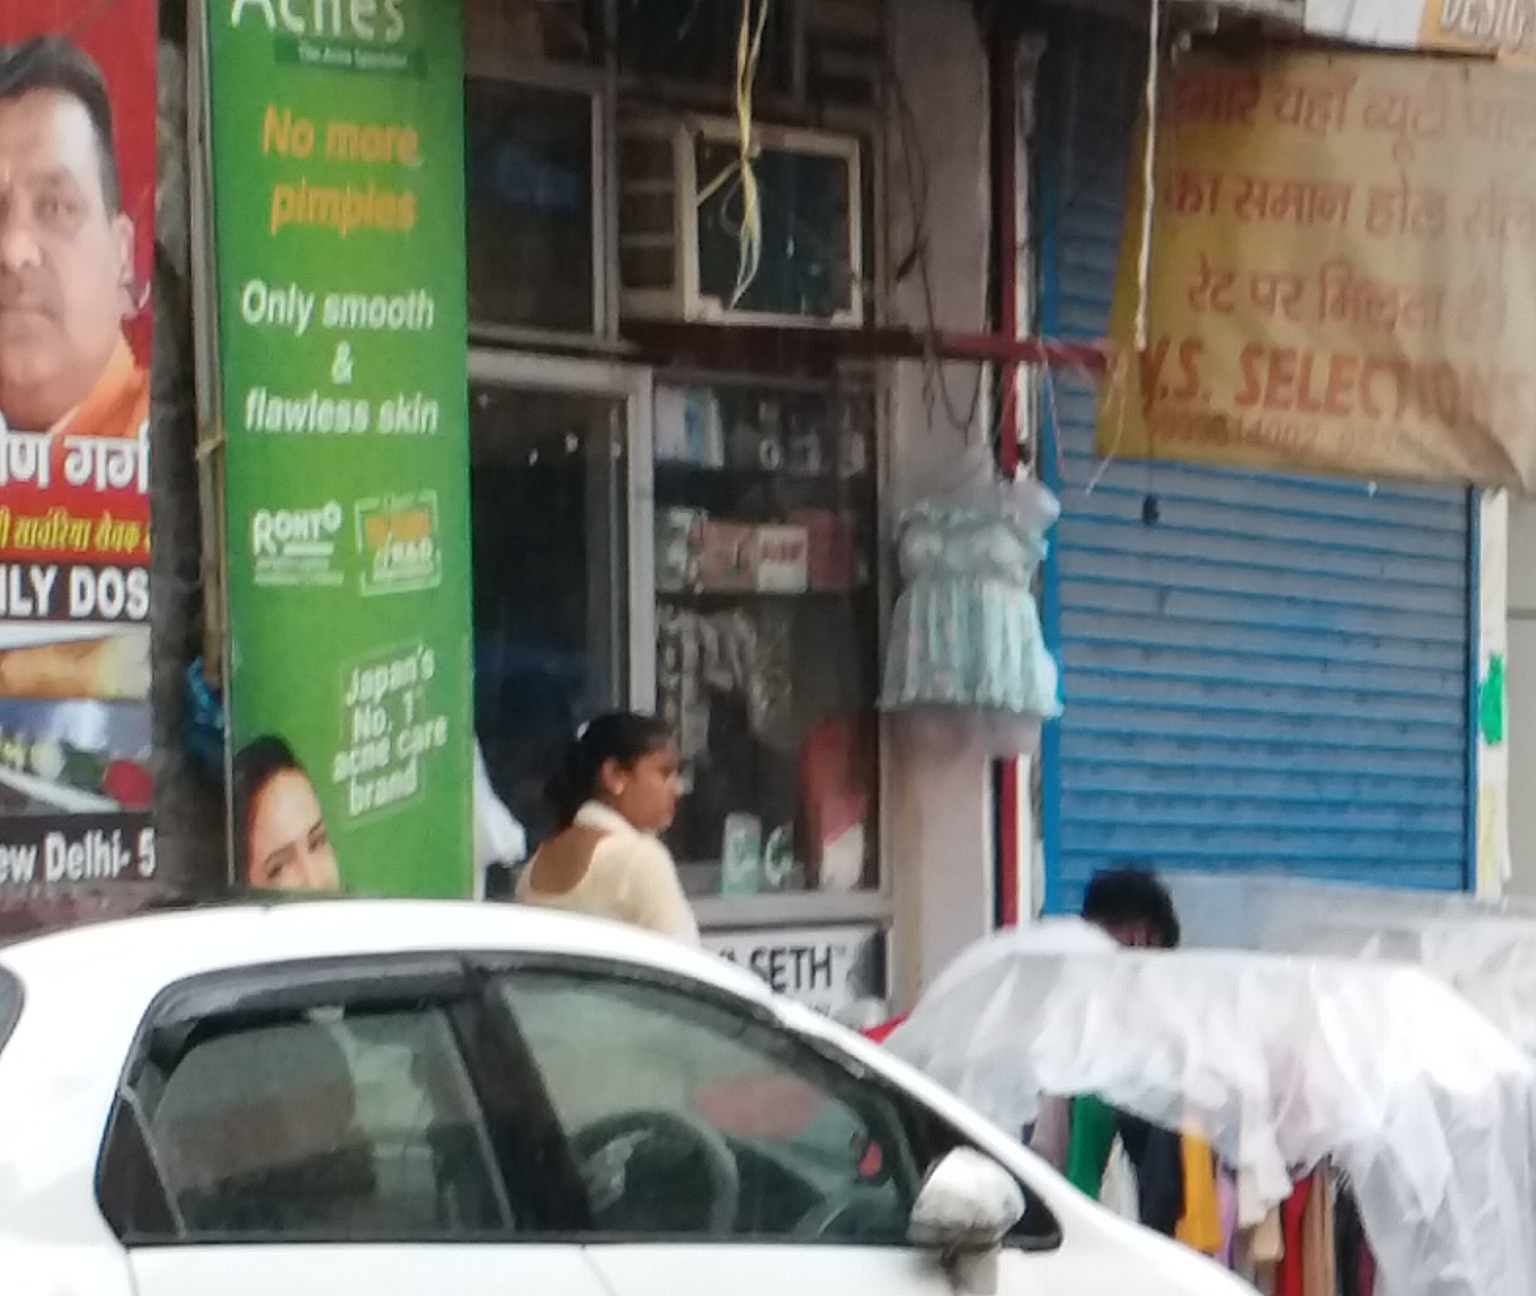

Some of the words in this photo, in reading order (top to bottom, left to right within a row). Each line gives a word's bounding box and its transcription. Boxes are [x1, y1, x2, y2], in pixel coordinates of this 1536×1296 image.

[262, 104, 315, 159] No
[325, 121, 419, 167] more
[269, 180, 418, 239] pimples
[1234, 173, 1353, 230] समान
[241, 278, 314, 337] Only
[322, 288, 435, 331] smooth
[1187, 252, 1239, 316] रेट
[1248, 272, 1306, 321] पर
[331, 339, 353, 385] &
[244, 386, 371, 435] flawless
[376, 390, 440, 435] skin
[345, 643, 436, 708] Japan's
[353, 702, 394, 743] No.
[401, 690, 415, 726] 1
[331, 735, 392, 784] acne
[393, 714, 449, 762] care
[349, 751, 419, 817] brand
[750, 944, 832, 994] SETH
